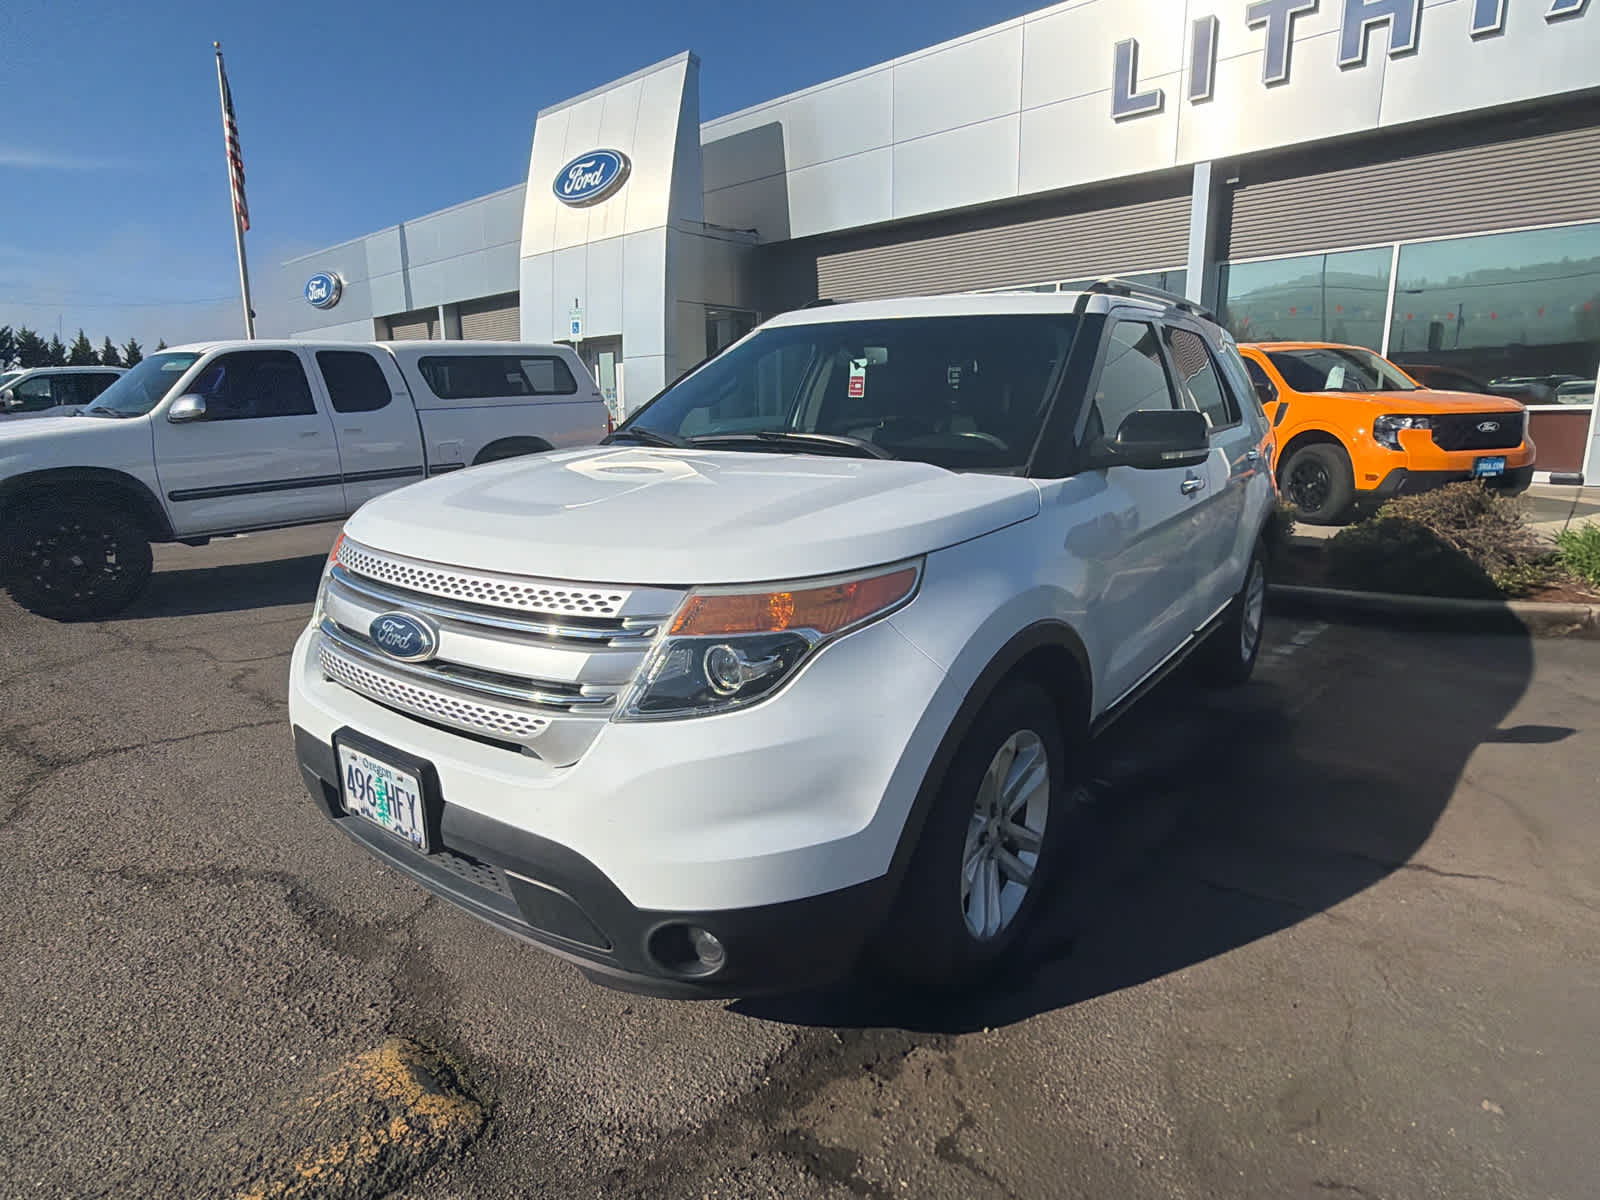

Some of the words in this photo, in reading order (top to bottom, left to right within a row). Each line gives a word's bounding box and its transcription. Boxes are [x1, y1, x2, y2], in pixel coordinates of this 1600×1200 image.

[1112, 0, 1587, 121] LITH
[564, 160, 605, 194] Ford
[309, 280, 327, 300] Ford
[378, 619, 413, 649] Ford
[362, 758, 392, 780] Oregon
[347, 764, 376, 807] 496
[385, 781, 416, 830] HFY
